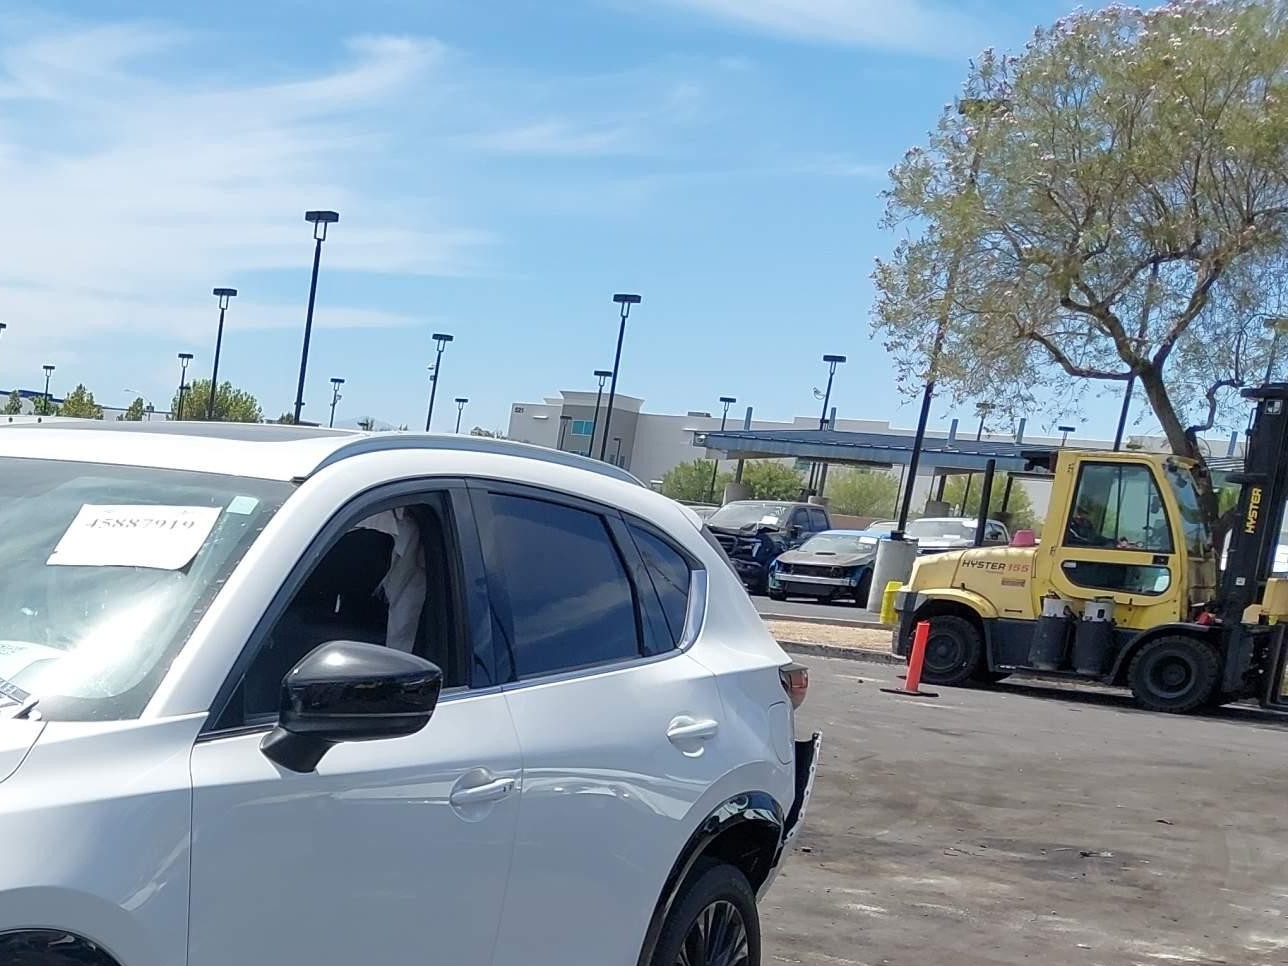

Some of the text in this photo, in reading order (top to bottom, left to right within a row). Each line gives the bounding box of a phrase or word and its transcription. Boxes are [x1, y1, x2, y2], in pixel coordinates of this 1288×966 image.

[1244, 487, 1263, 534] HYSTER
[85, 518, 195, 529] 45887919
[962, 559, 1006, 571] HYSTER
[1007, 563, 1030, 573] 155
